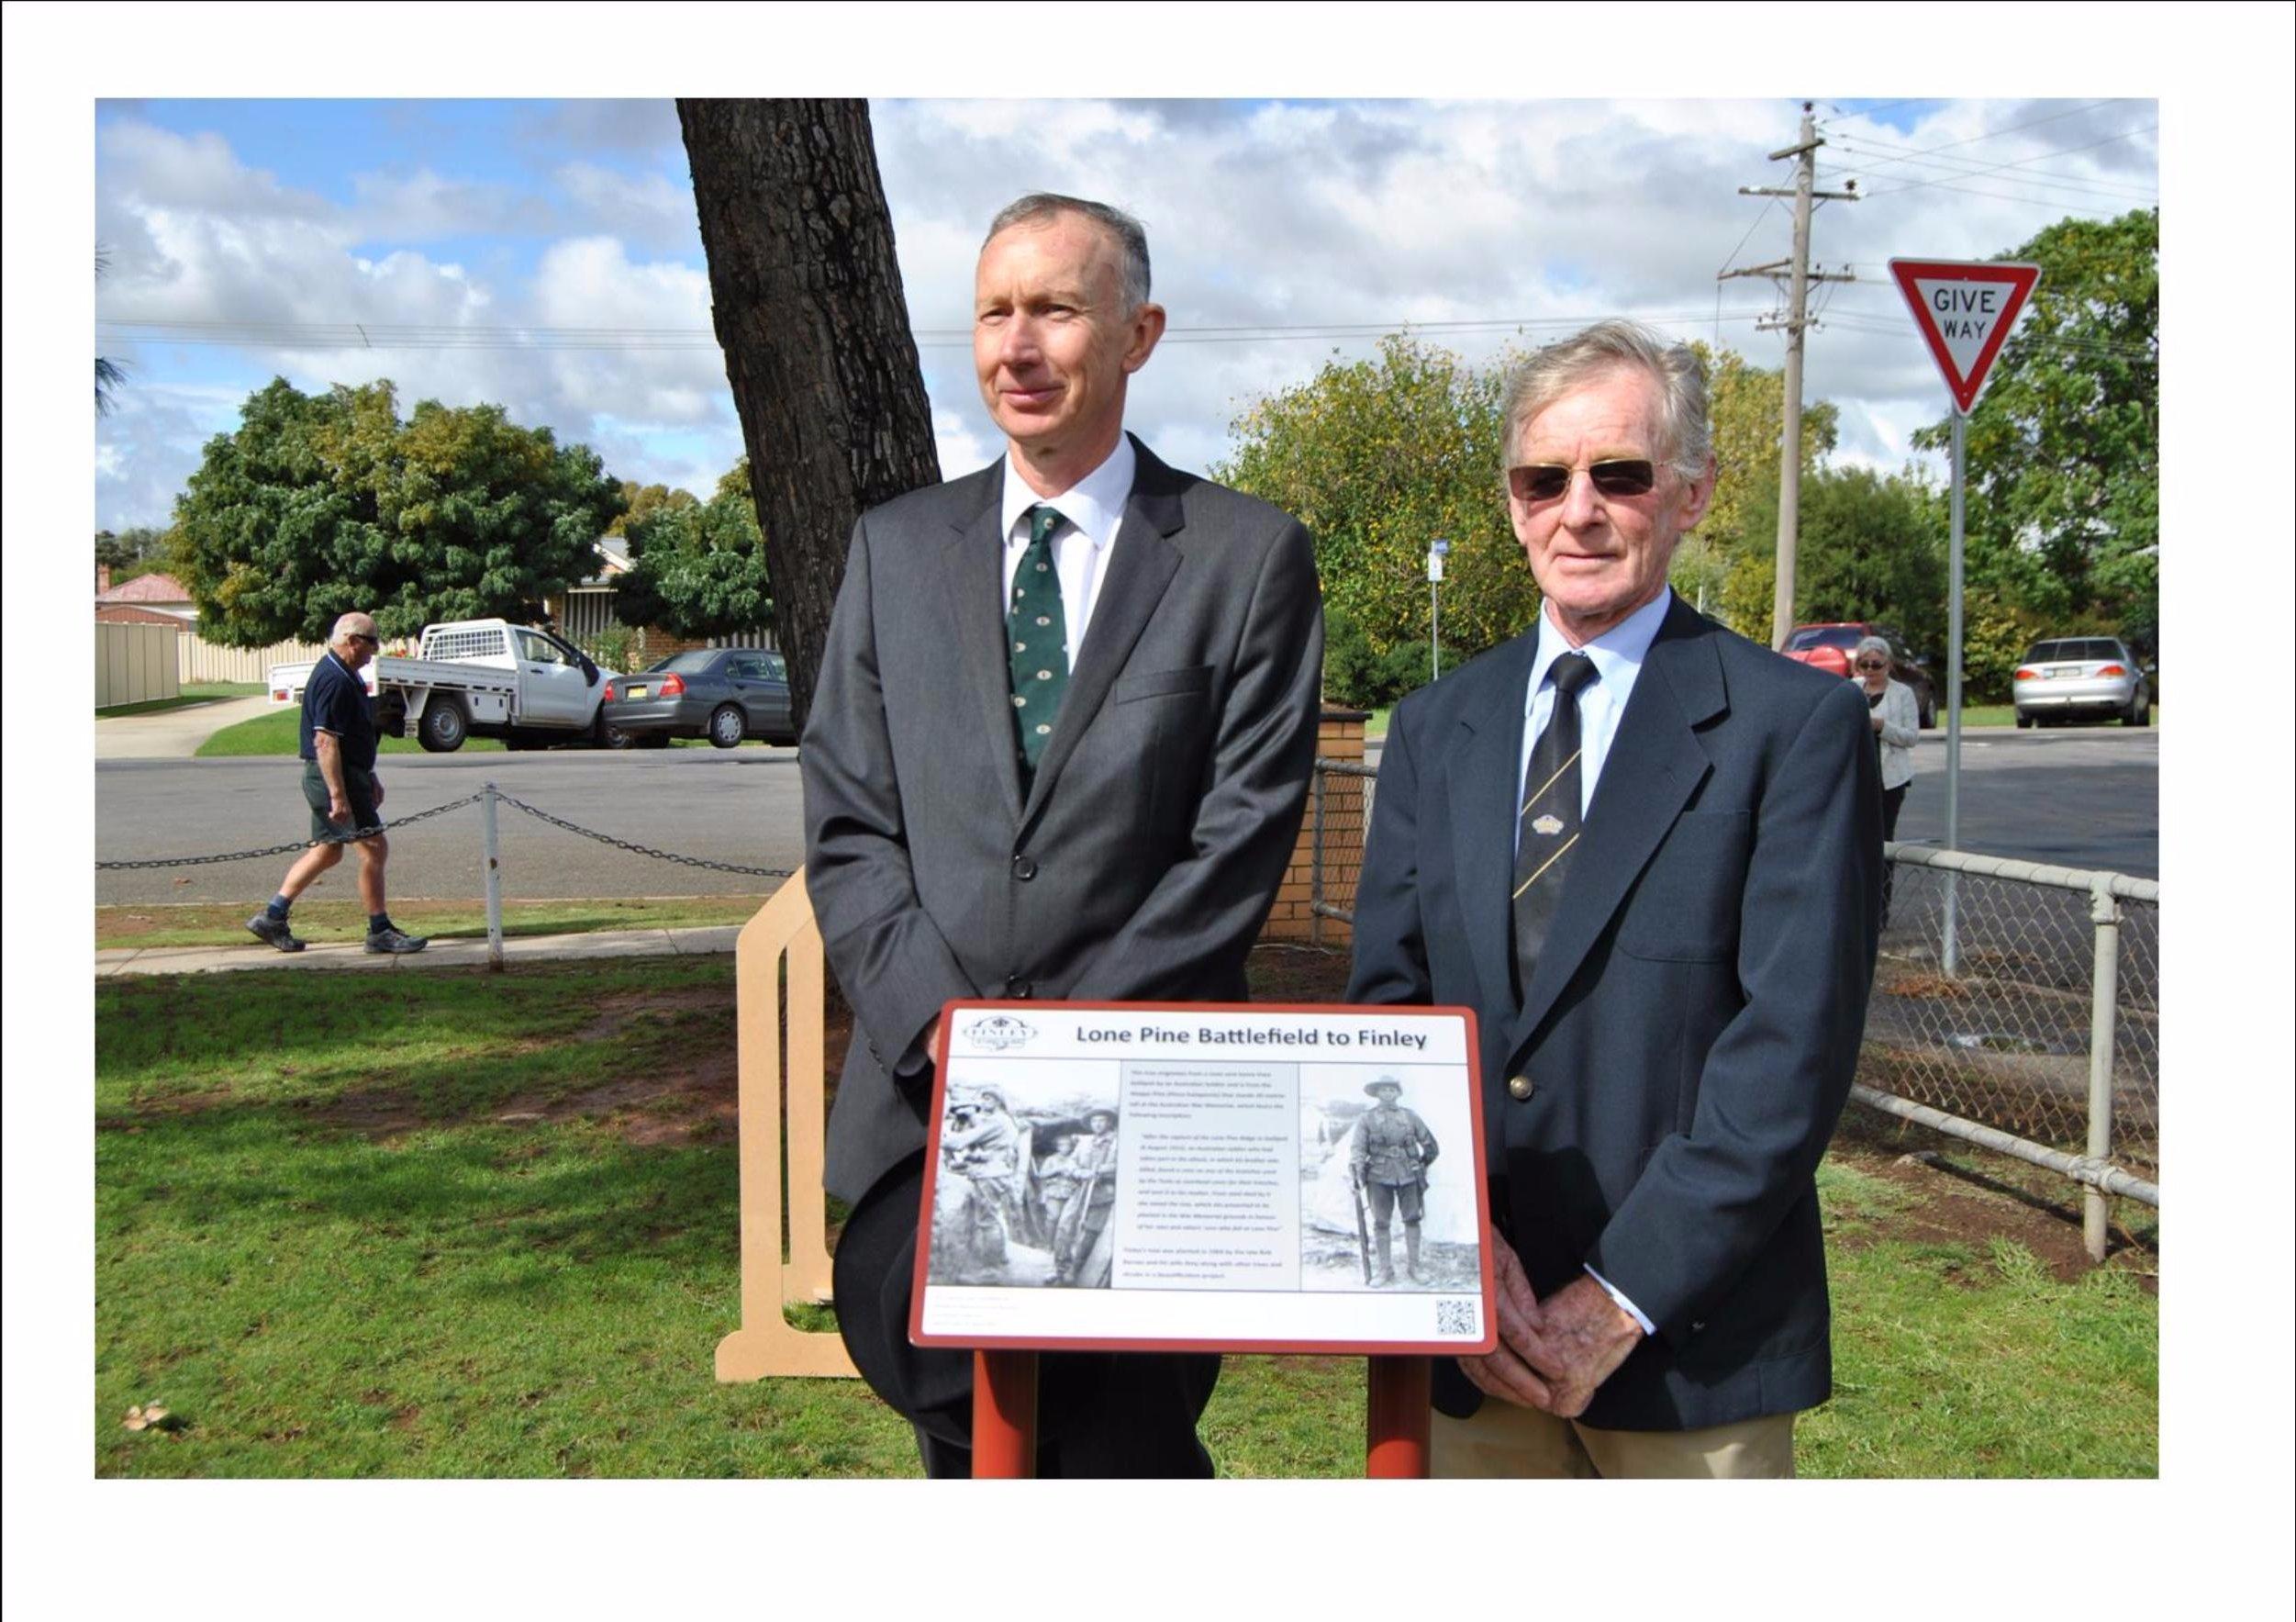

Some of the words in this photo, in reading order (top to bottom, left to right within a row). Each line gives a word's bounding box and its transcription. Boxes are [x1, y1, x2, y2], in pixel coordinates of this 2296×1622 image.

[1934, 288, 1996, 313] GIVE
[1944, 320, 1987, 339] WAY
[1076, 1025, 1132, 1044] Lone
[1139, 1026, 1190, 1044] Pine
[1198, 1027, 1319, 1046] Battlefield
[1326, 1031, 1351, 1046] to
[1358, 1029, 1427, 1050] Finley
